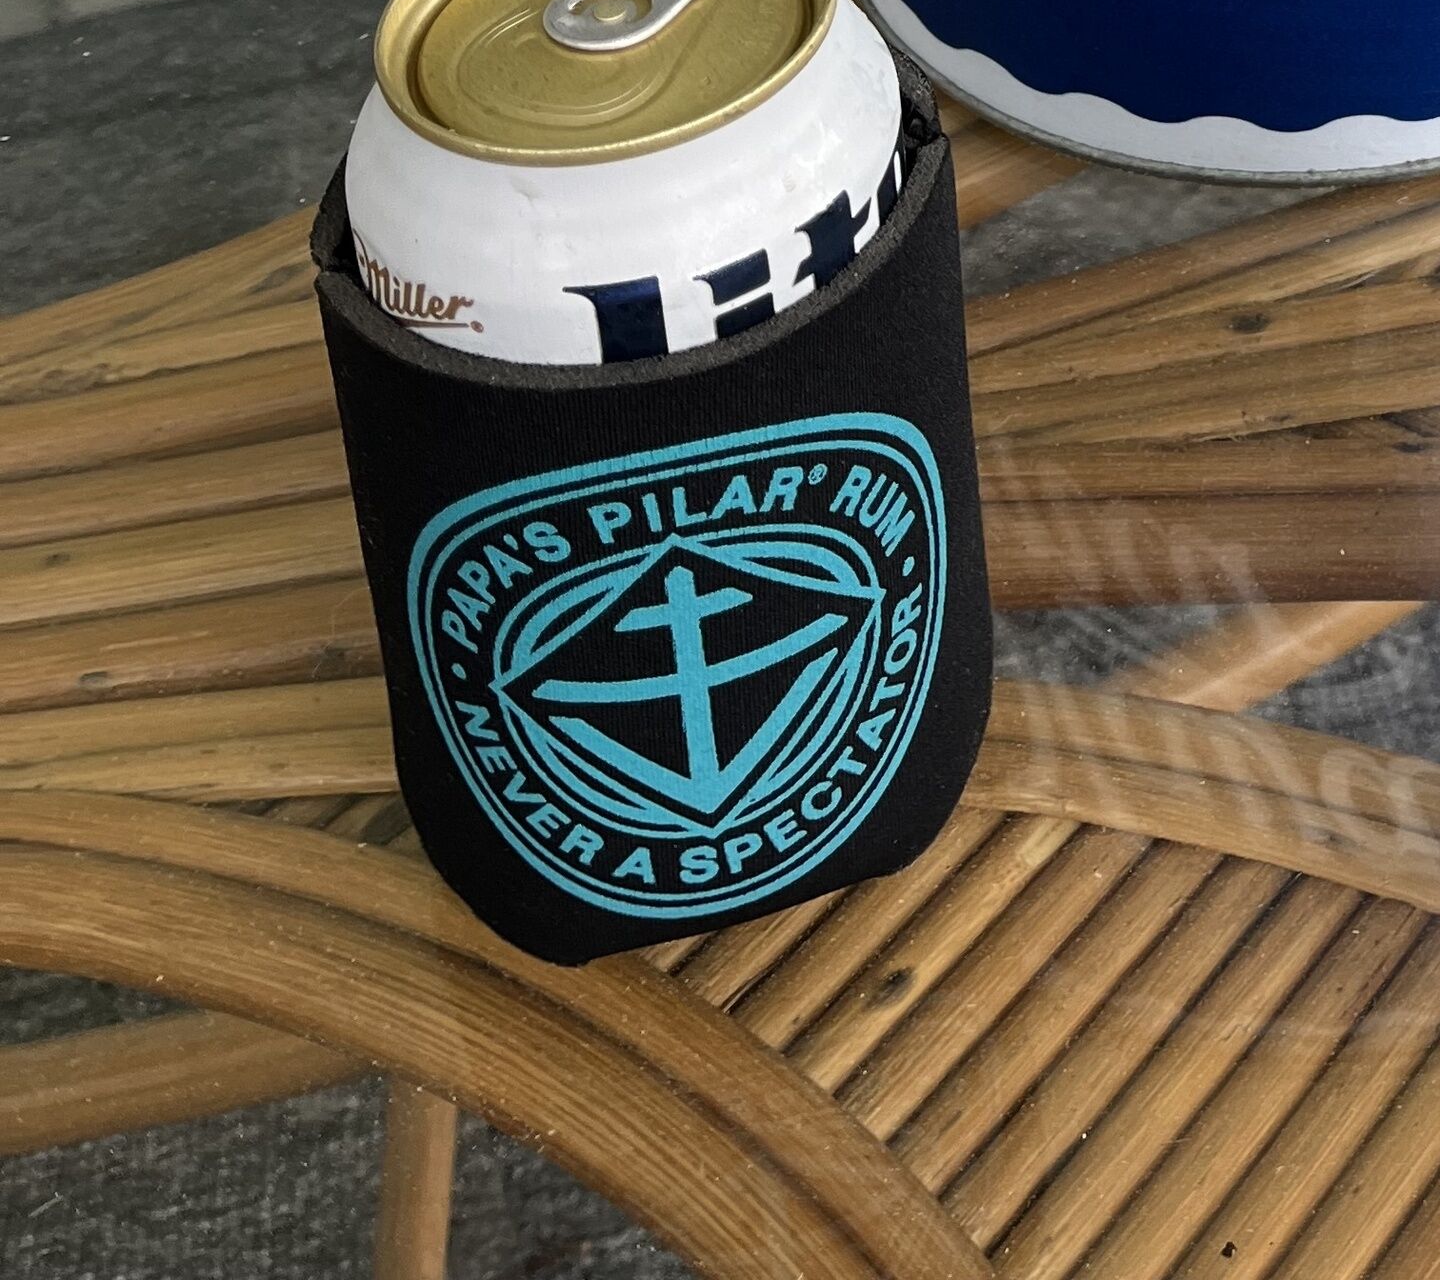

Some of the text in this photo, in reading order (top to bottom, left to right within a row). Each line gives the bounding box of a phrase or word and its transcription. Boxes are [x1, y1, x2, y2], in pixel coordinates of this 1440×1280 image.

[440, 520, 572, 654] PAPA'S
[829, 464, 917, 557] RUM
[460, 582, 924, 887] NEVER A SPECTATOR
